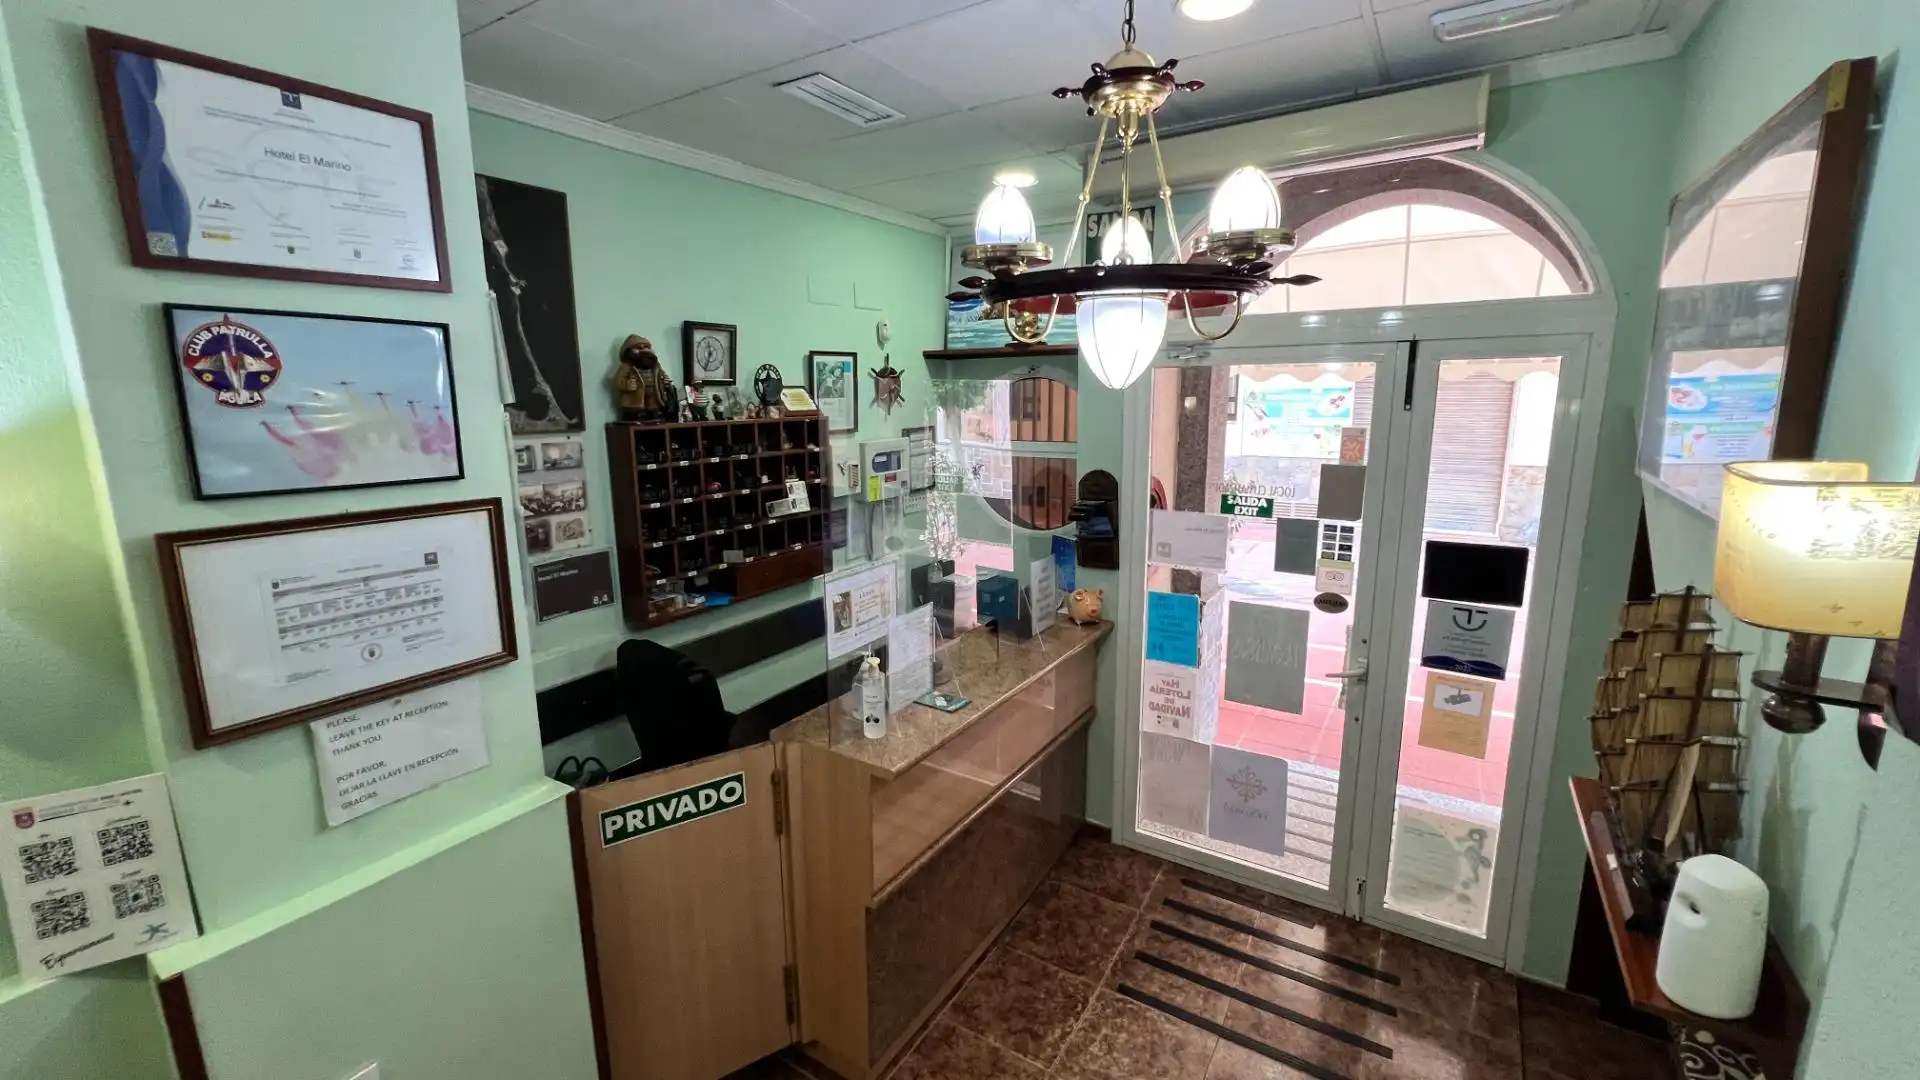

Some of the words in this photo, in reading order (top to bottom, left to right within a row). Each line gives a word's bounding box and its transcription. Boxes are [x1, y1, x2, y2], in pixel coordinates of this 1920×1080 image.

[264, 147, 296, 161] Hotel
[298, 152, 311, 164] El
[313, 156, 352, 172] Marino
[1087, 208, 1154, 238] SAA
[188, 329, 213, 357] CLUB
[211, 325, 273, 359] PATRULLA
[1226, 495, 1268, 508] SALIDA
[1234, 505, 1259, 516] EXIT
[592, 593, 608, 605] 8,4
[329, 729, 356, 743] LEAVE
[357, 723, 373, 734] THE
[375, 717, 391, 728] KEY
[392, 713, 403, 722] AT
[404, 700, 449, 719] RECEPTION
[332, 740, 361, 757] THANK
[335, 771, 355, 784] POR
[338, 781, 365, 797] DEJAR
[366, 777, 378, 788] LA
[378, 769, 402, 783] LLAVE
[404, 762, 416, 772] EN
[604, 780, 743, 840] PRIVADO
